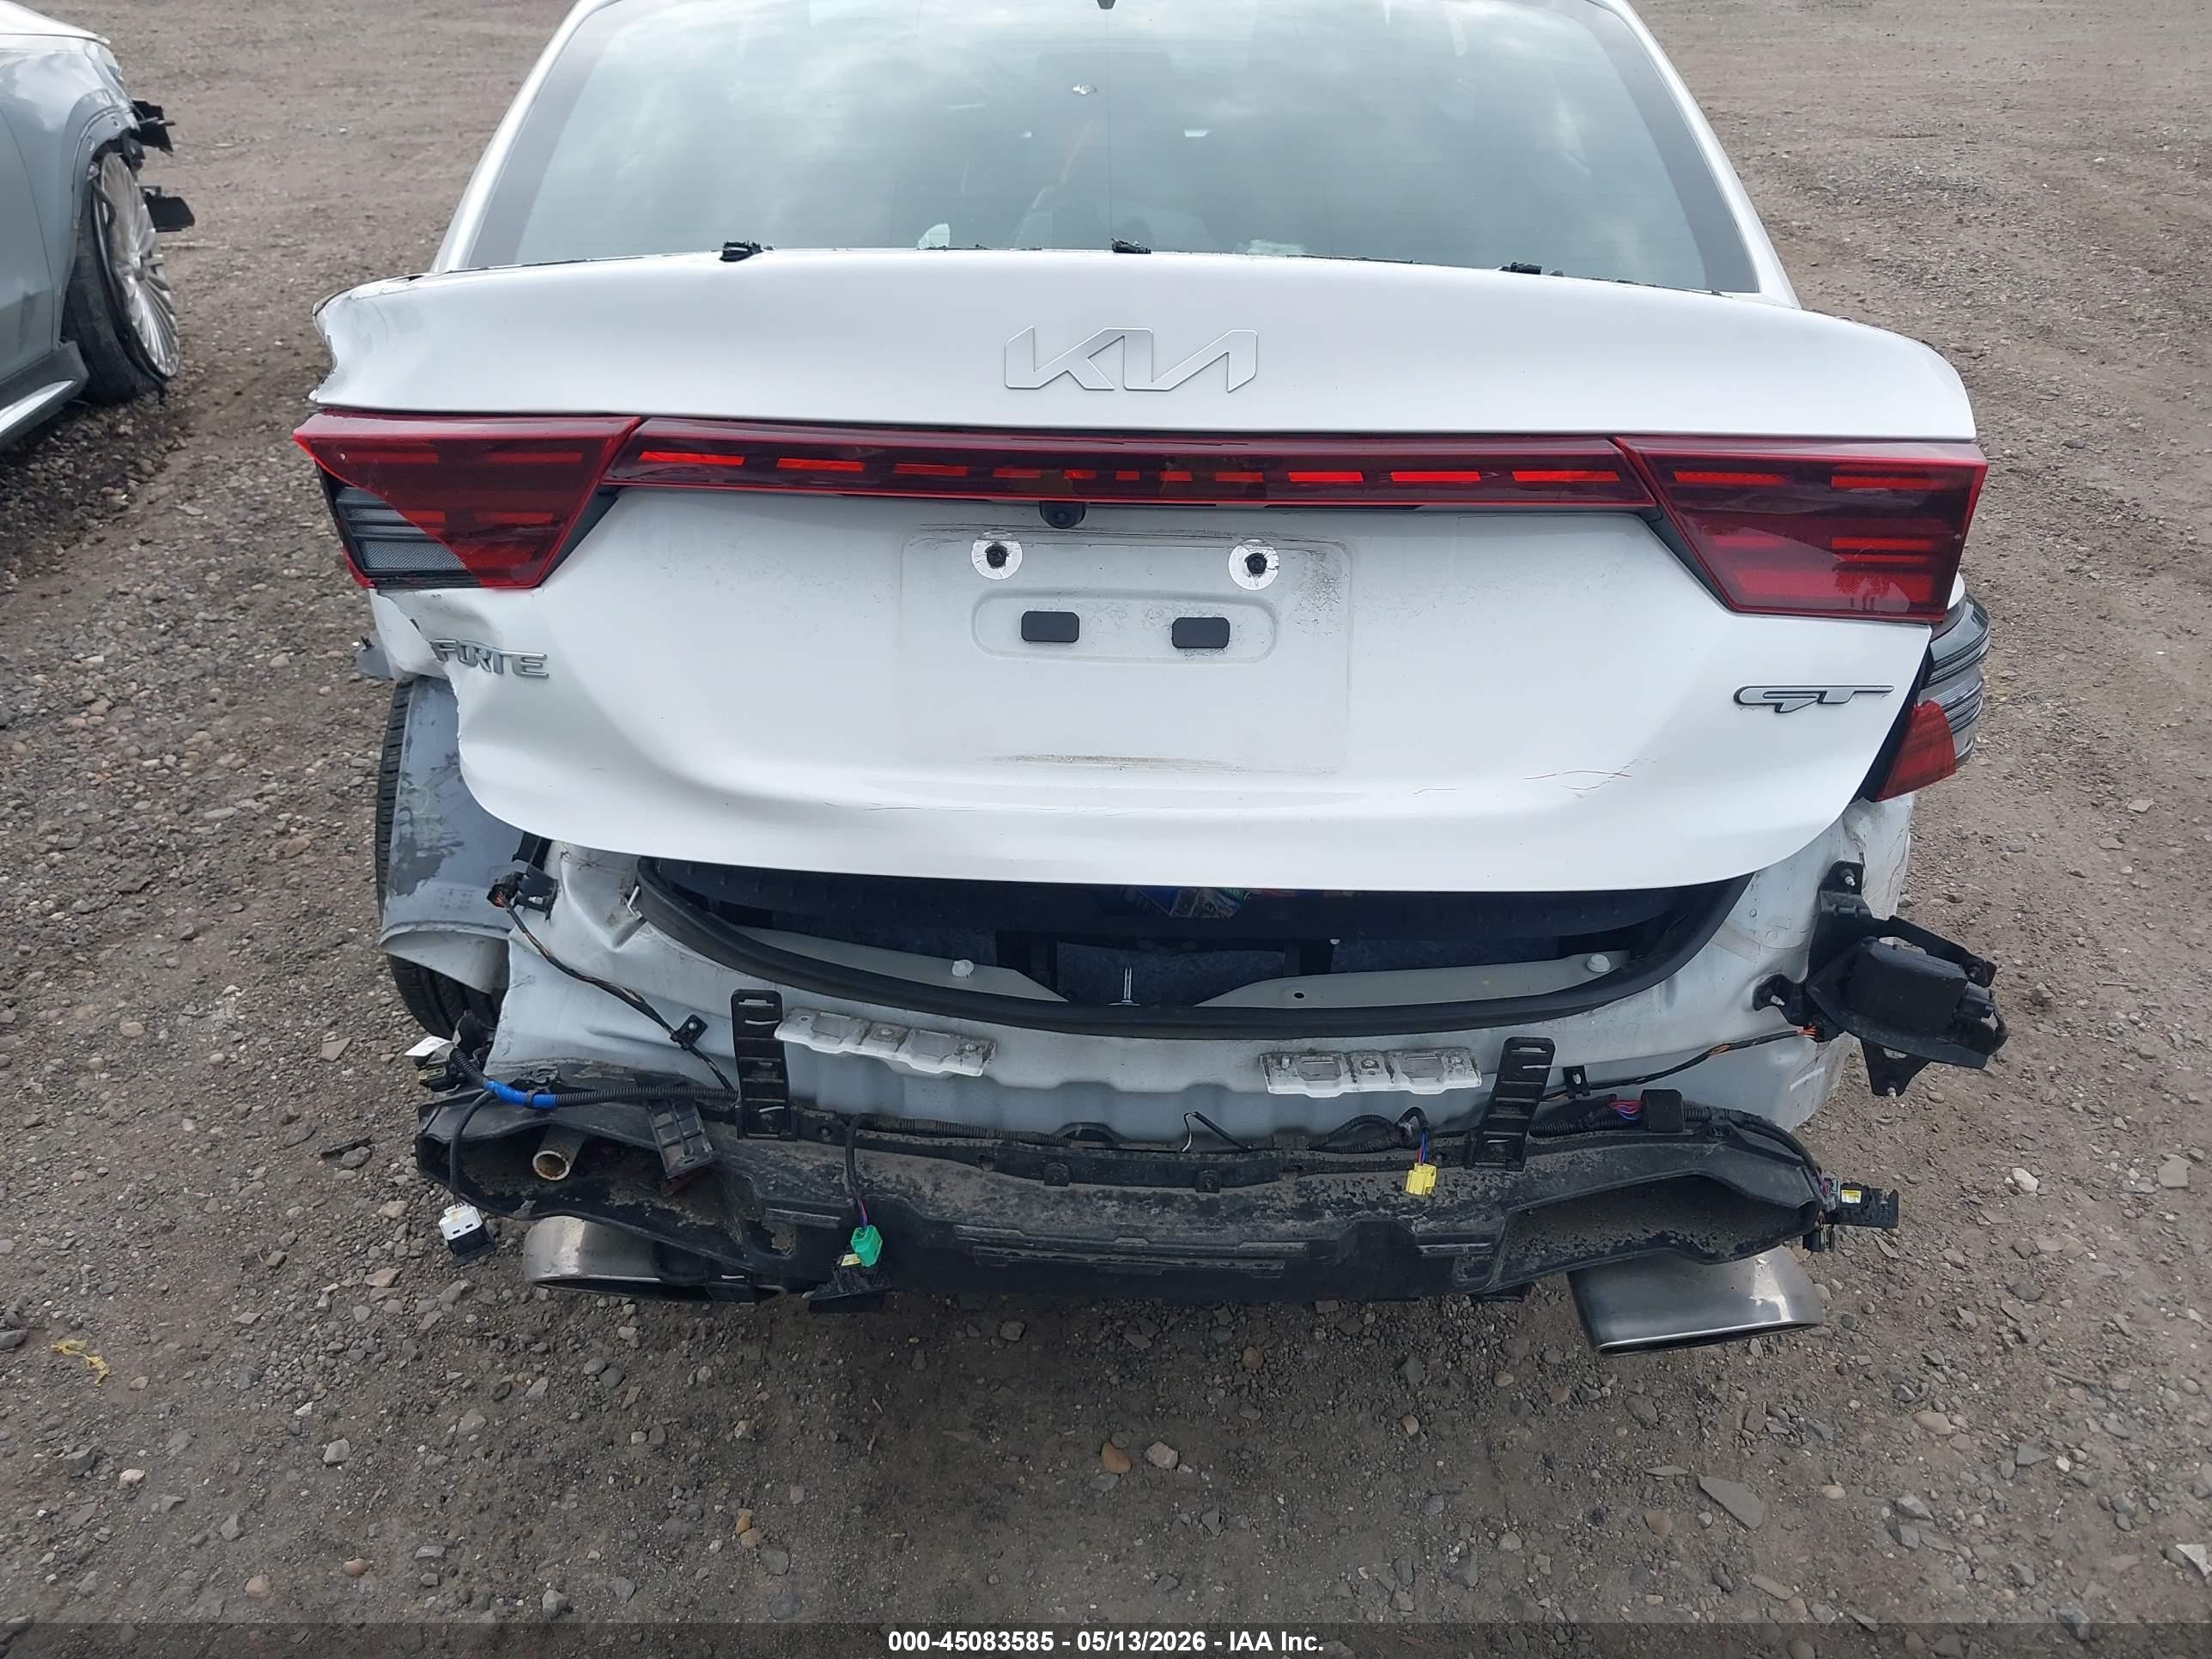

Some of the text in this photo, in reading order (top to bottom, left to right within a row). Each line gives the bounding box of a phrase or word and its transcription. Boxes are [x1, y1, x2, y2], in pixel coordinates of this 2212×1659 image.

[1004, 325, 1258, 393] KIA
[430, 638, 550, 679] FORTE
[1733, 684, 1895, 714] GT
